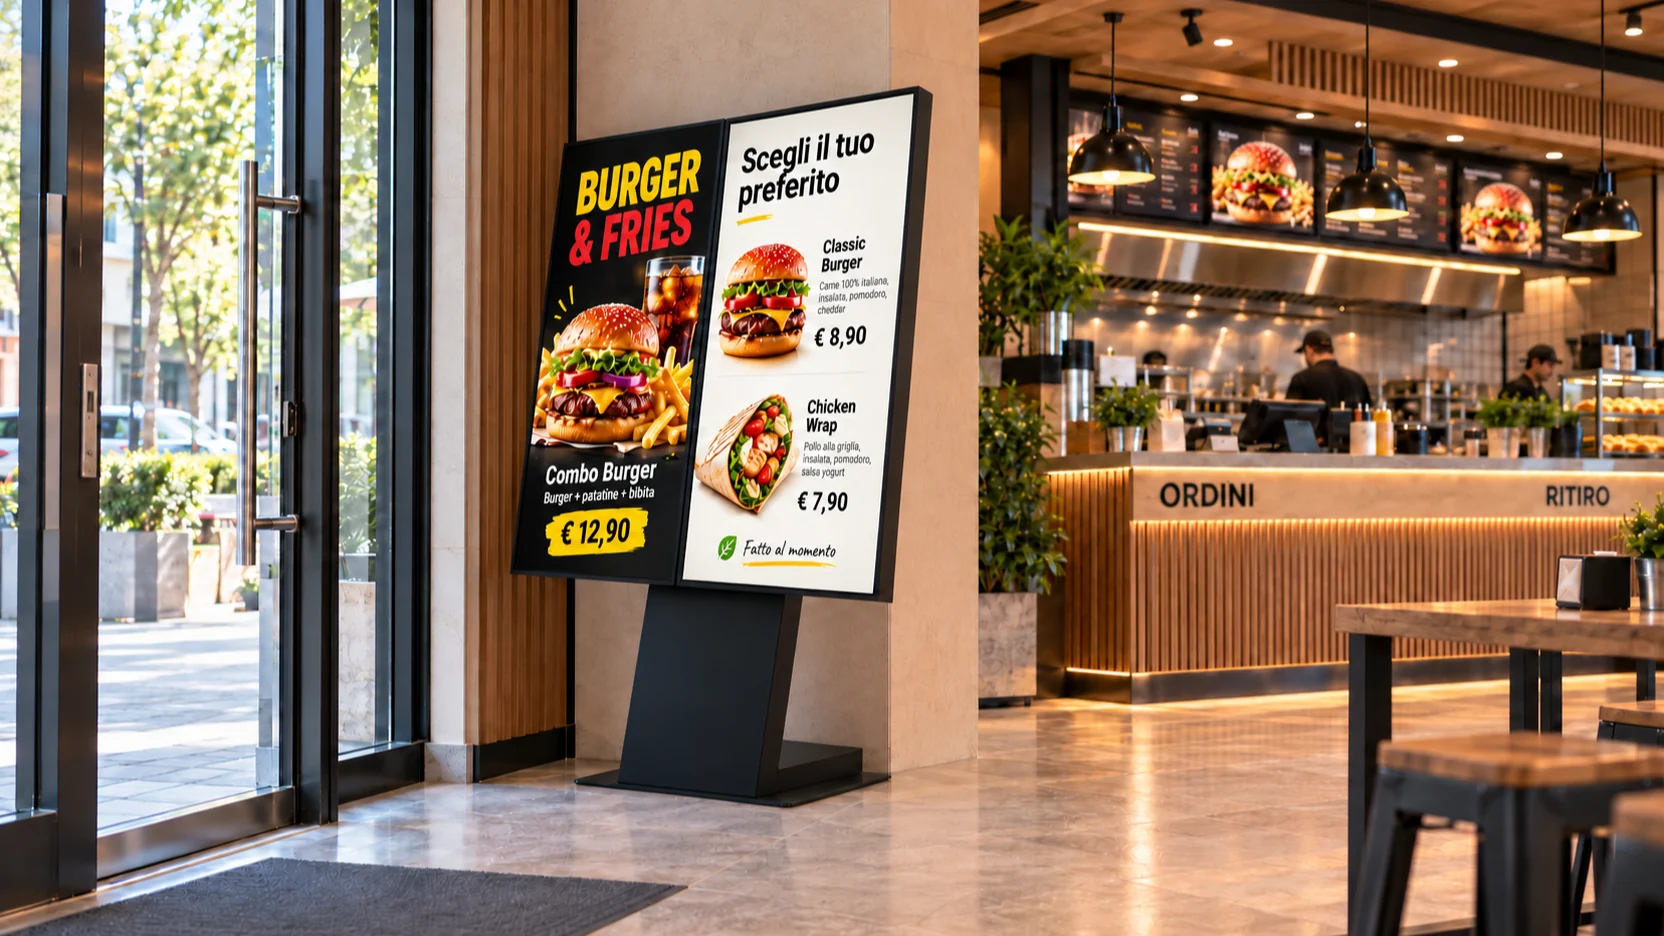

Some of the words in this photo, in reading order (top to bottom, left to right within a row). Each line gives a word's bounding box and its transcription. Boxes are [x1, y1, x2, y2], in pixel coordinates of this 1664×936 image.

[741, 136, 811, 174] Scegli
[816, 132, 830, 161] il
[836, 132, 875, 158] tuo
[576, 149, 702, 216] BURGER
[738, 168, 840, 213] preferito
[569, 219, 594, 267] &
[600, 198, 694, 261] FRIES
[823, 235, 866, 254] Classic
[821, 257, 863, 274] Burger
[842, 278, 860, 289] 100%
[861, 276, 889, 287] italiana,
[849, 289, 887, 302] pomodoro,
[817, 304, 846, 315] cheddar
[814, 327, 825, 347] €
[829, 325, 867, 349] 8,90
[807, 398, 856, 414] Chicken
[806, 417, 838, 436] Wrap
[803, 441, 821, 451] Pollo
[822, 441, 836, 451] alla
[837, 441, 861, 453] griglia,
[802, 453, 832, 465] insalata,
[833, 454, 872, 466] pomodoro,
[545, 462, 599, 486] Combo
[602, 461, 657, 485] Burger
[801, 466, 820, 477] salsa
[821, 468, 845, 479] yogurt
[543, 491, 573, 506] Burger
[574, 492, 580, 501] +
[581, 488, 619, 504] patatine
[620, 489, 627, 498] +
[628, 485, 655, 499] bibita
[797, 491, 808, 511] €
[812, 491, 848, 515] 7,90
[1160, 482, 1254, 508] ORDINI
[1546, 485, 1610, 507] RITIRO
[561, 520, 574, 545] €
[579, 517, 631, 549] 12,90
[743, 539, 771, 557] Fatto
[775, 540, 787, 556] al
[788, 544, 836, 558] momento
